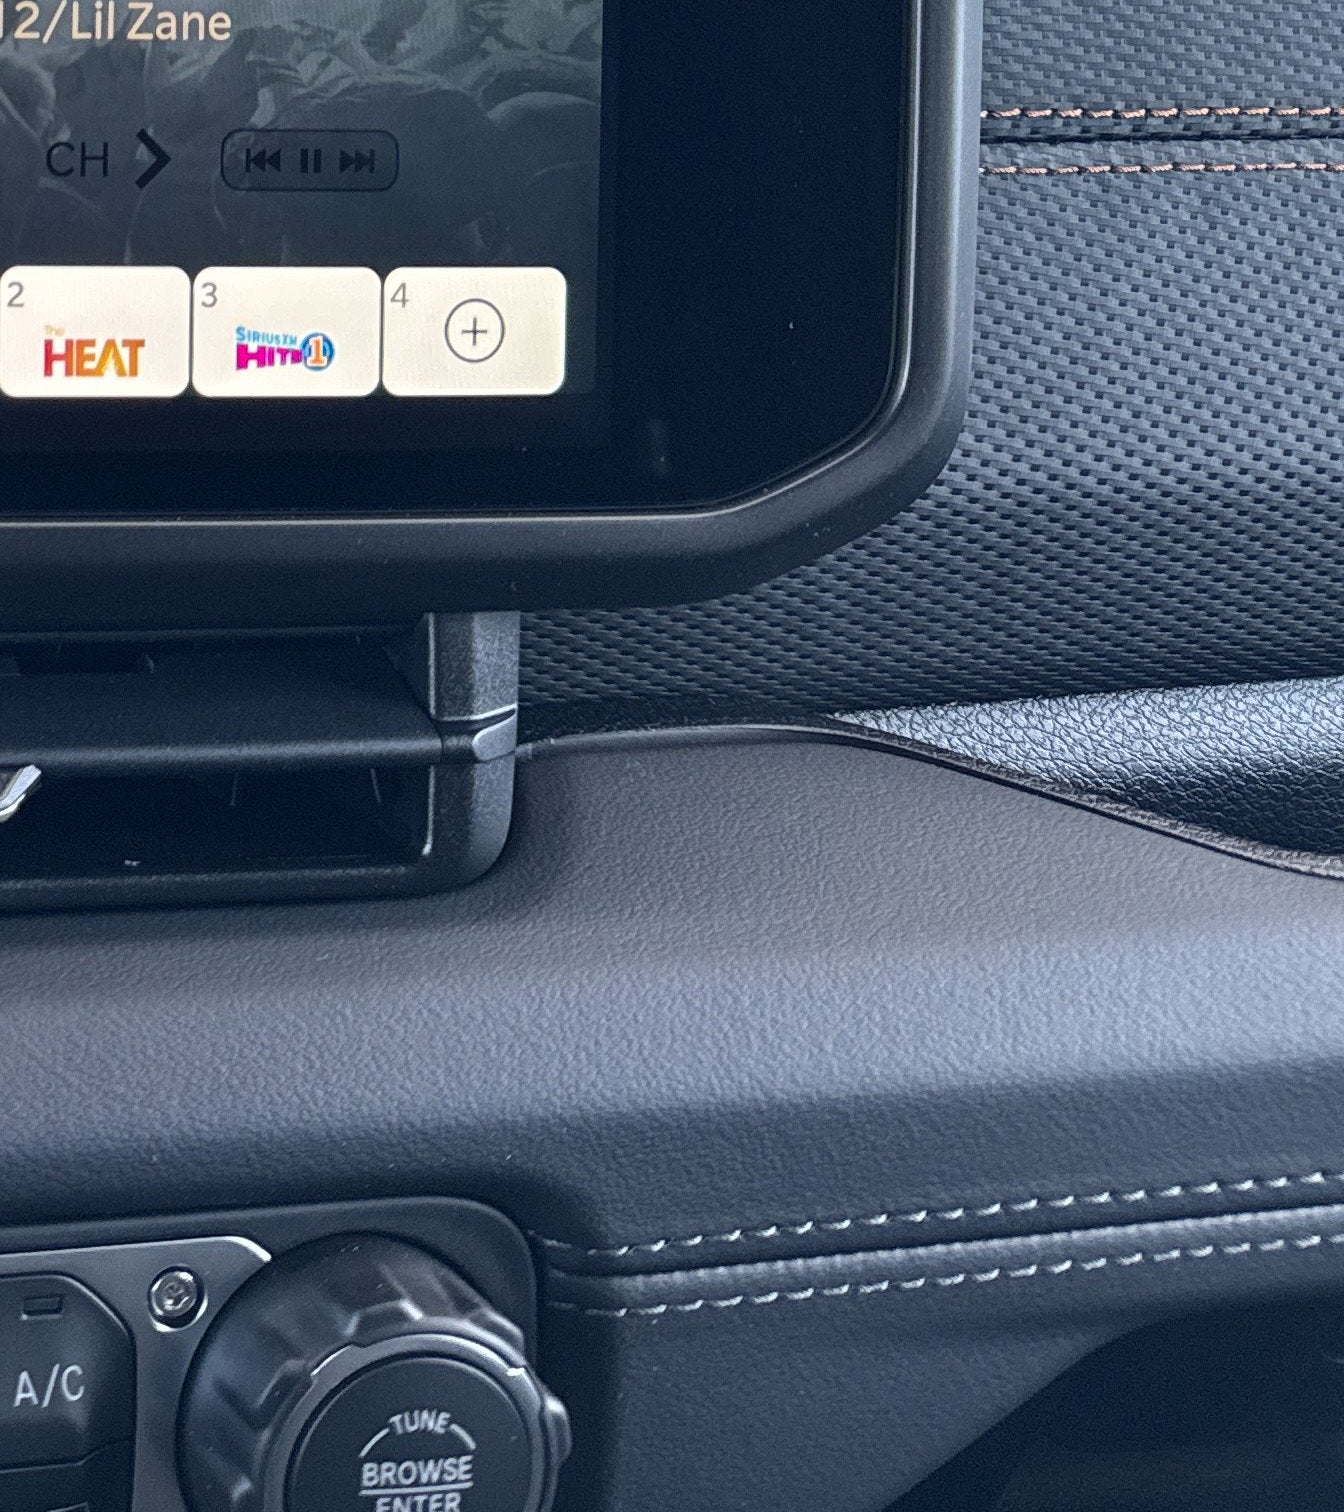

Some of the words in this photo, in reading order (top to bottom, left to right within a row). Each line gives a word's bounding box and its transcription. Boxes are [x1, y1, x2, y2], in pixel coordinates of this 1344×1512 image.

[126, 1, 232, 42] Zane
[45, 142, 109, 178] CH
[6, 282, 25, 309] 2
[201, 282, 218, 308] 3
[390, 282, 410, 308] 4
[43, 338, 145, 378] HEAT
[12, 1366, 86, 1409] A/C
[388, 1408, 452, 1436] TUNE
[361, 1454, 475, 1487] BROWSE
[375, 1492, 462, 1512] ENTER
